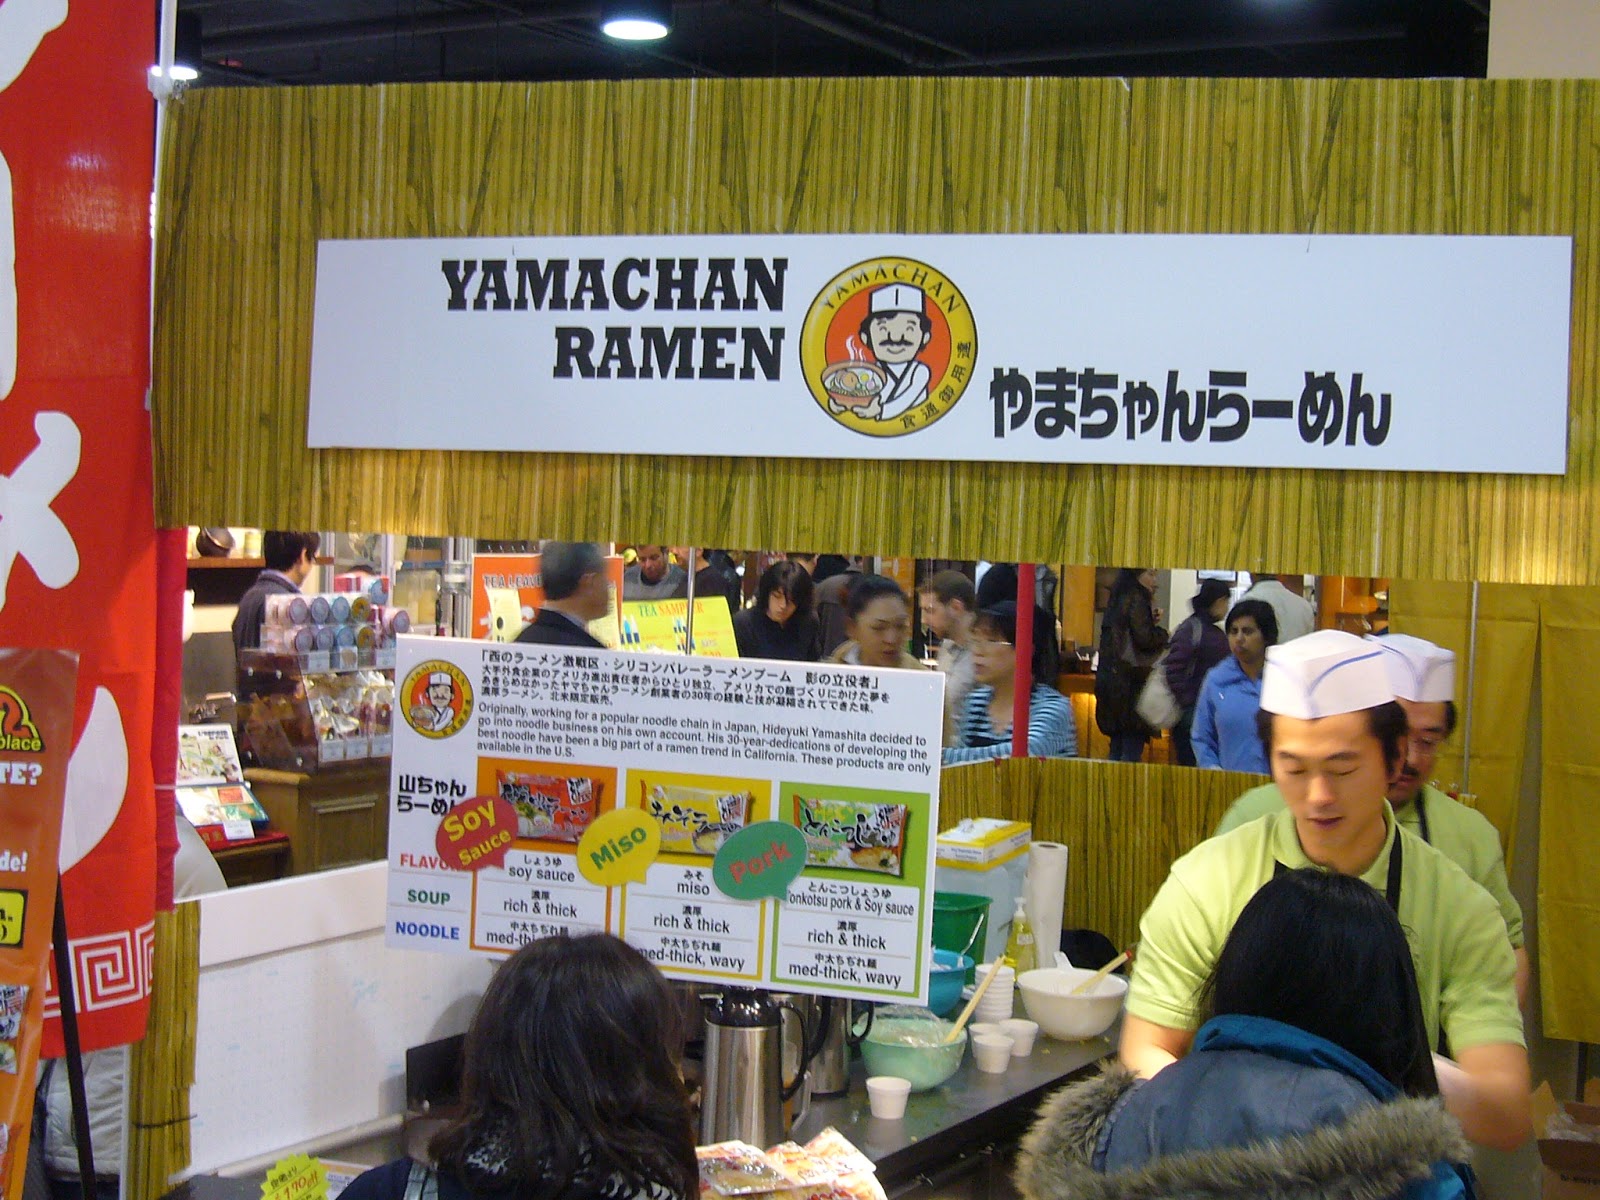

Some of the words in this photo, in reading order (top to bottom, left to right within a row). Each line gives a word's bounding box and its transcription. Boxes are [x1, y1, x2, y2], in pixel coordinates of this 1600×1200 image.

[441, 257, 788, 312] YAMACHAN
[819, 262, 962, 314] YAMACHAN
[552, 325, 786, 381] RAMEN
[989, 367, 1392, 447] やまちゃんらーめん
[483, 574, 505, 588] TEA
[639, 603, 658, 616] TEA
[478, 702, 529, 717] Originally,
[532, 706, 572, 721] working
[574, 709, 589, 720] for
[600, 711, 638, 725] popular
[642, 713, 678, 726] noodle
[681, 716, 709, 729] chain
[724, 721, 759, 735] Japan,
[762, 723, 809, 738] Hideyuki
[811, 728, 867, 742] Yamashita
[870, 732, 913, 745] decided
[494, 716, 513, 727] into
[516, 718, 550, 730] noodle
[553, 720, 598, 734] business
[617, 725, 632, 736] his
[635, 729, 657, 739] own
[660, 730, 705, 742] account.
[707, 733, 724, 744] His
[727, 735, 831, 753] 30-year-dedications
[848, 744, 907, 760] developing
[910, 749, 928, 760] the
[477, 741, 521, 754] available
[535, 744, 551, 756] the
[554, 747, 575, 758] U.S.
[477, 728, 499, 739] best
[502, 729, 536, 742] noodle
[539, 732, 563, 744] have
[565, 734, 590, 746] been
[602, 737, 618, 750] big
[620, 739, 640, 751] part
[665, 744, 699, 755] ramen
[701, 745, 728, 757] trend
[744, 749, 798, 763] California.
[801, 753, 833, 765] These
[836, 757, 884, 770] products
[887, 761, 905, 771] are
[908, 762, 931, 776] only
[399, 774, 467, 797] 山ちゃん
[397, 795, 456, 817] らーめ
[443, 799, 497, 842] Soy
[458, 828, 511, 866] sauce
[590, 827, 647, 871] Miso
[524, 854, 562, 868] しょうゆ
[729, 842, 792, 884] Pork
[509, 867, 533, 882] soy
[537, 870, 575, 883] sauce
[407, 889, 451, 906] SOUP
[677, 880, 711, 896] miso
[808, 881, 892, 899] とんこつしょうゆ
[503, 899, 528, 914] rich
[532, 901, 544, 914] &
[546, 903, 578, 918] thick
[788, 890, 828, 907] onkotsu
[830, 895, 852, 911] pork
[864, 898, 883, 916] Soy
[886, 902, 914, 916] sauce
[395, 921, 460, 940] NOODLE
[653, 914, 679, 929] rich
[683, 917, 697, 930] &
[698, 917, 731, 934] thick
[807, 930, 834, 945] rich
[838, 932, 852, 946] &
[852, 933, 887, 950] thick
[710, 956, 745, 973] wavy
[788, 963, 862, 984] med-thick,
[866, 971, 902, 989] wavy
